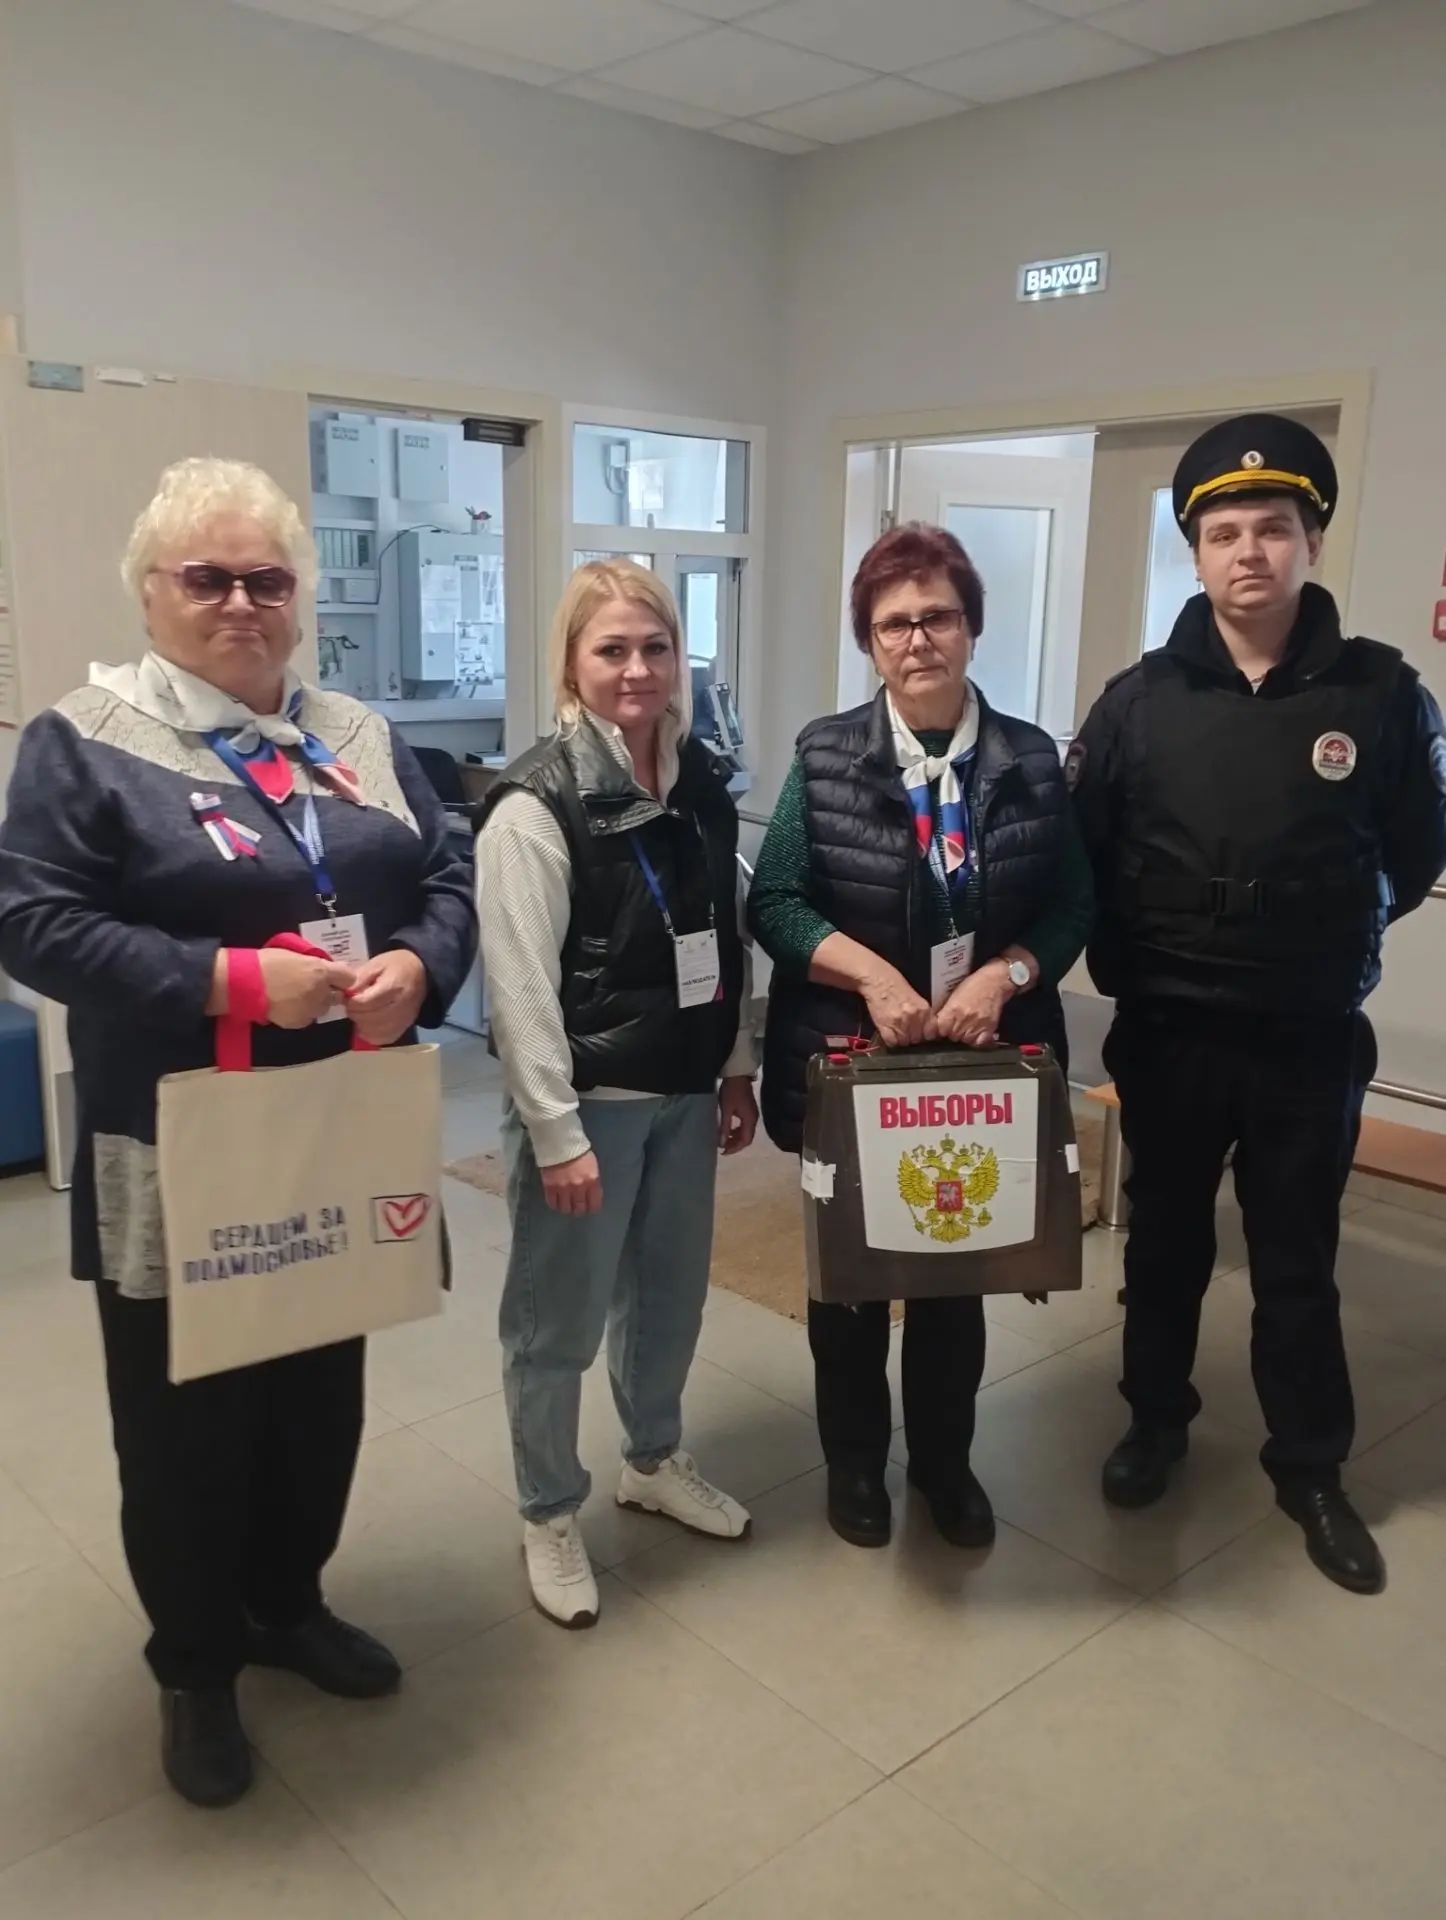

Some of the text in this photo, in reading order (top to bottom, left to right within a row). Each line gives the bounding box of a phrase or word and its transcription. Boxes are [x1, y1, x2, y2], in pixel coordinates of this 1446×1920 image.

[1026, 261, 1097, 291] ВЫХОД
[880, 1092, 1013, 1129] ВЫБОРЫ
[319, 1206, 346, 1230] ЗА
